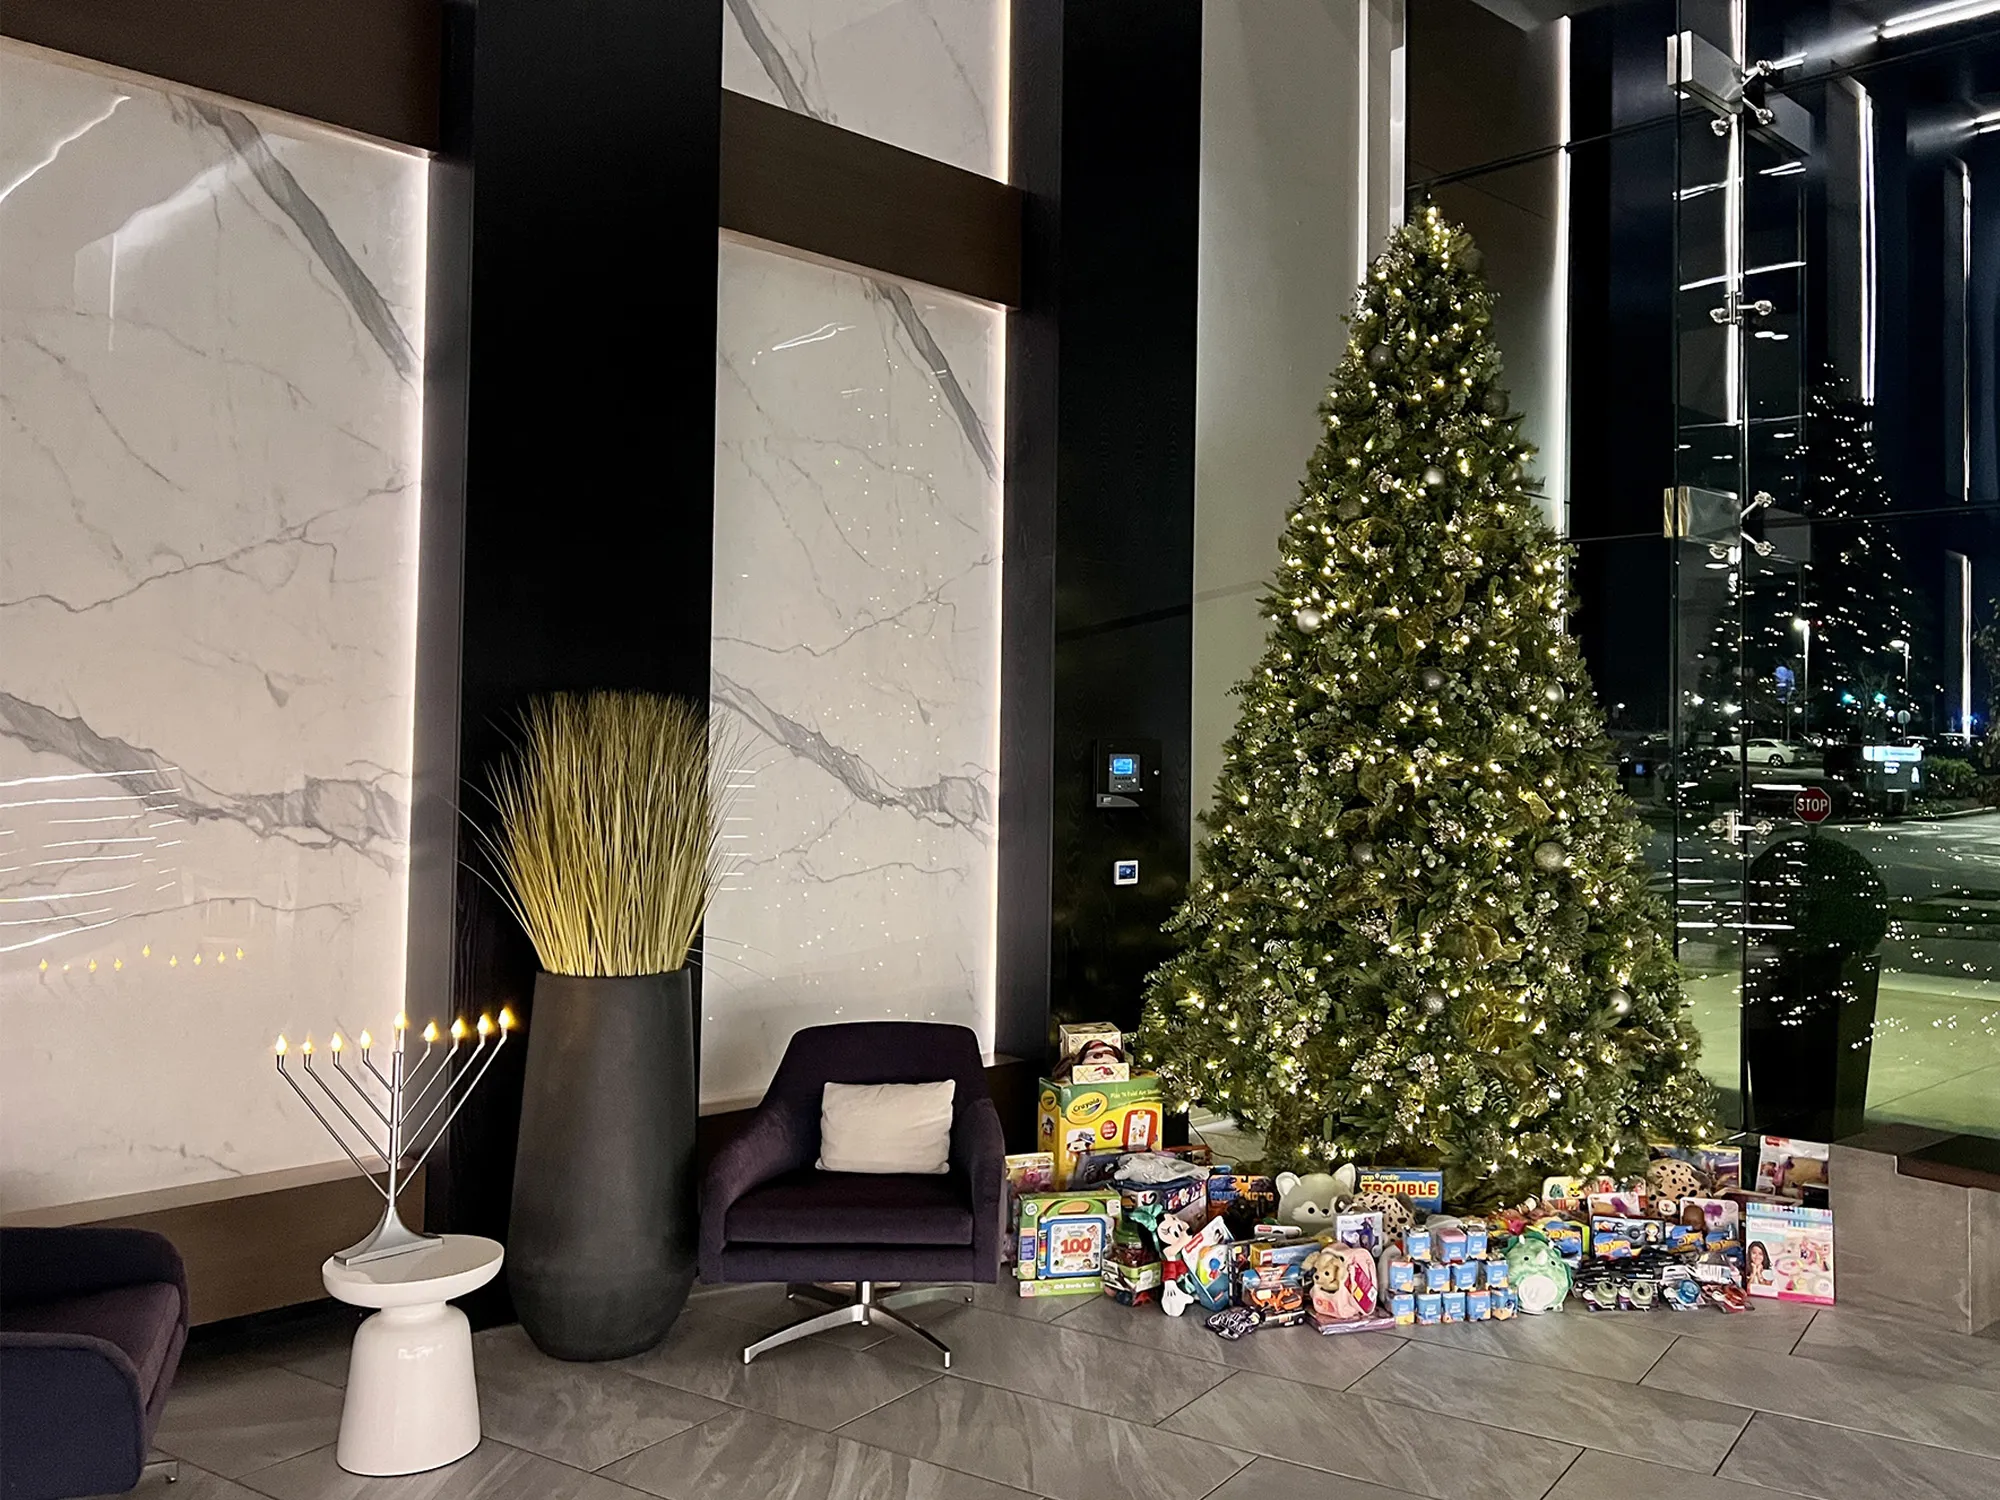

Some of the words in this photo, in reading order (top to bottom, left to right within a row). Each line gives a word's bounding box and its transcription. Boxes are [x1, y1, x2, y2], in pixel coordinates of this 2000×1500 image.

[1796, 797, 1828, 812] STOP
[1072, 1097, 1101, 1113] Crayola
[1361, 1182, 1438, 1196] TROUBLE
[1060, 1238, 1092, 1255] 100
